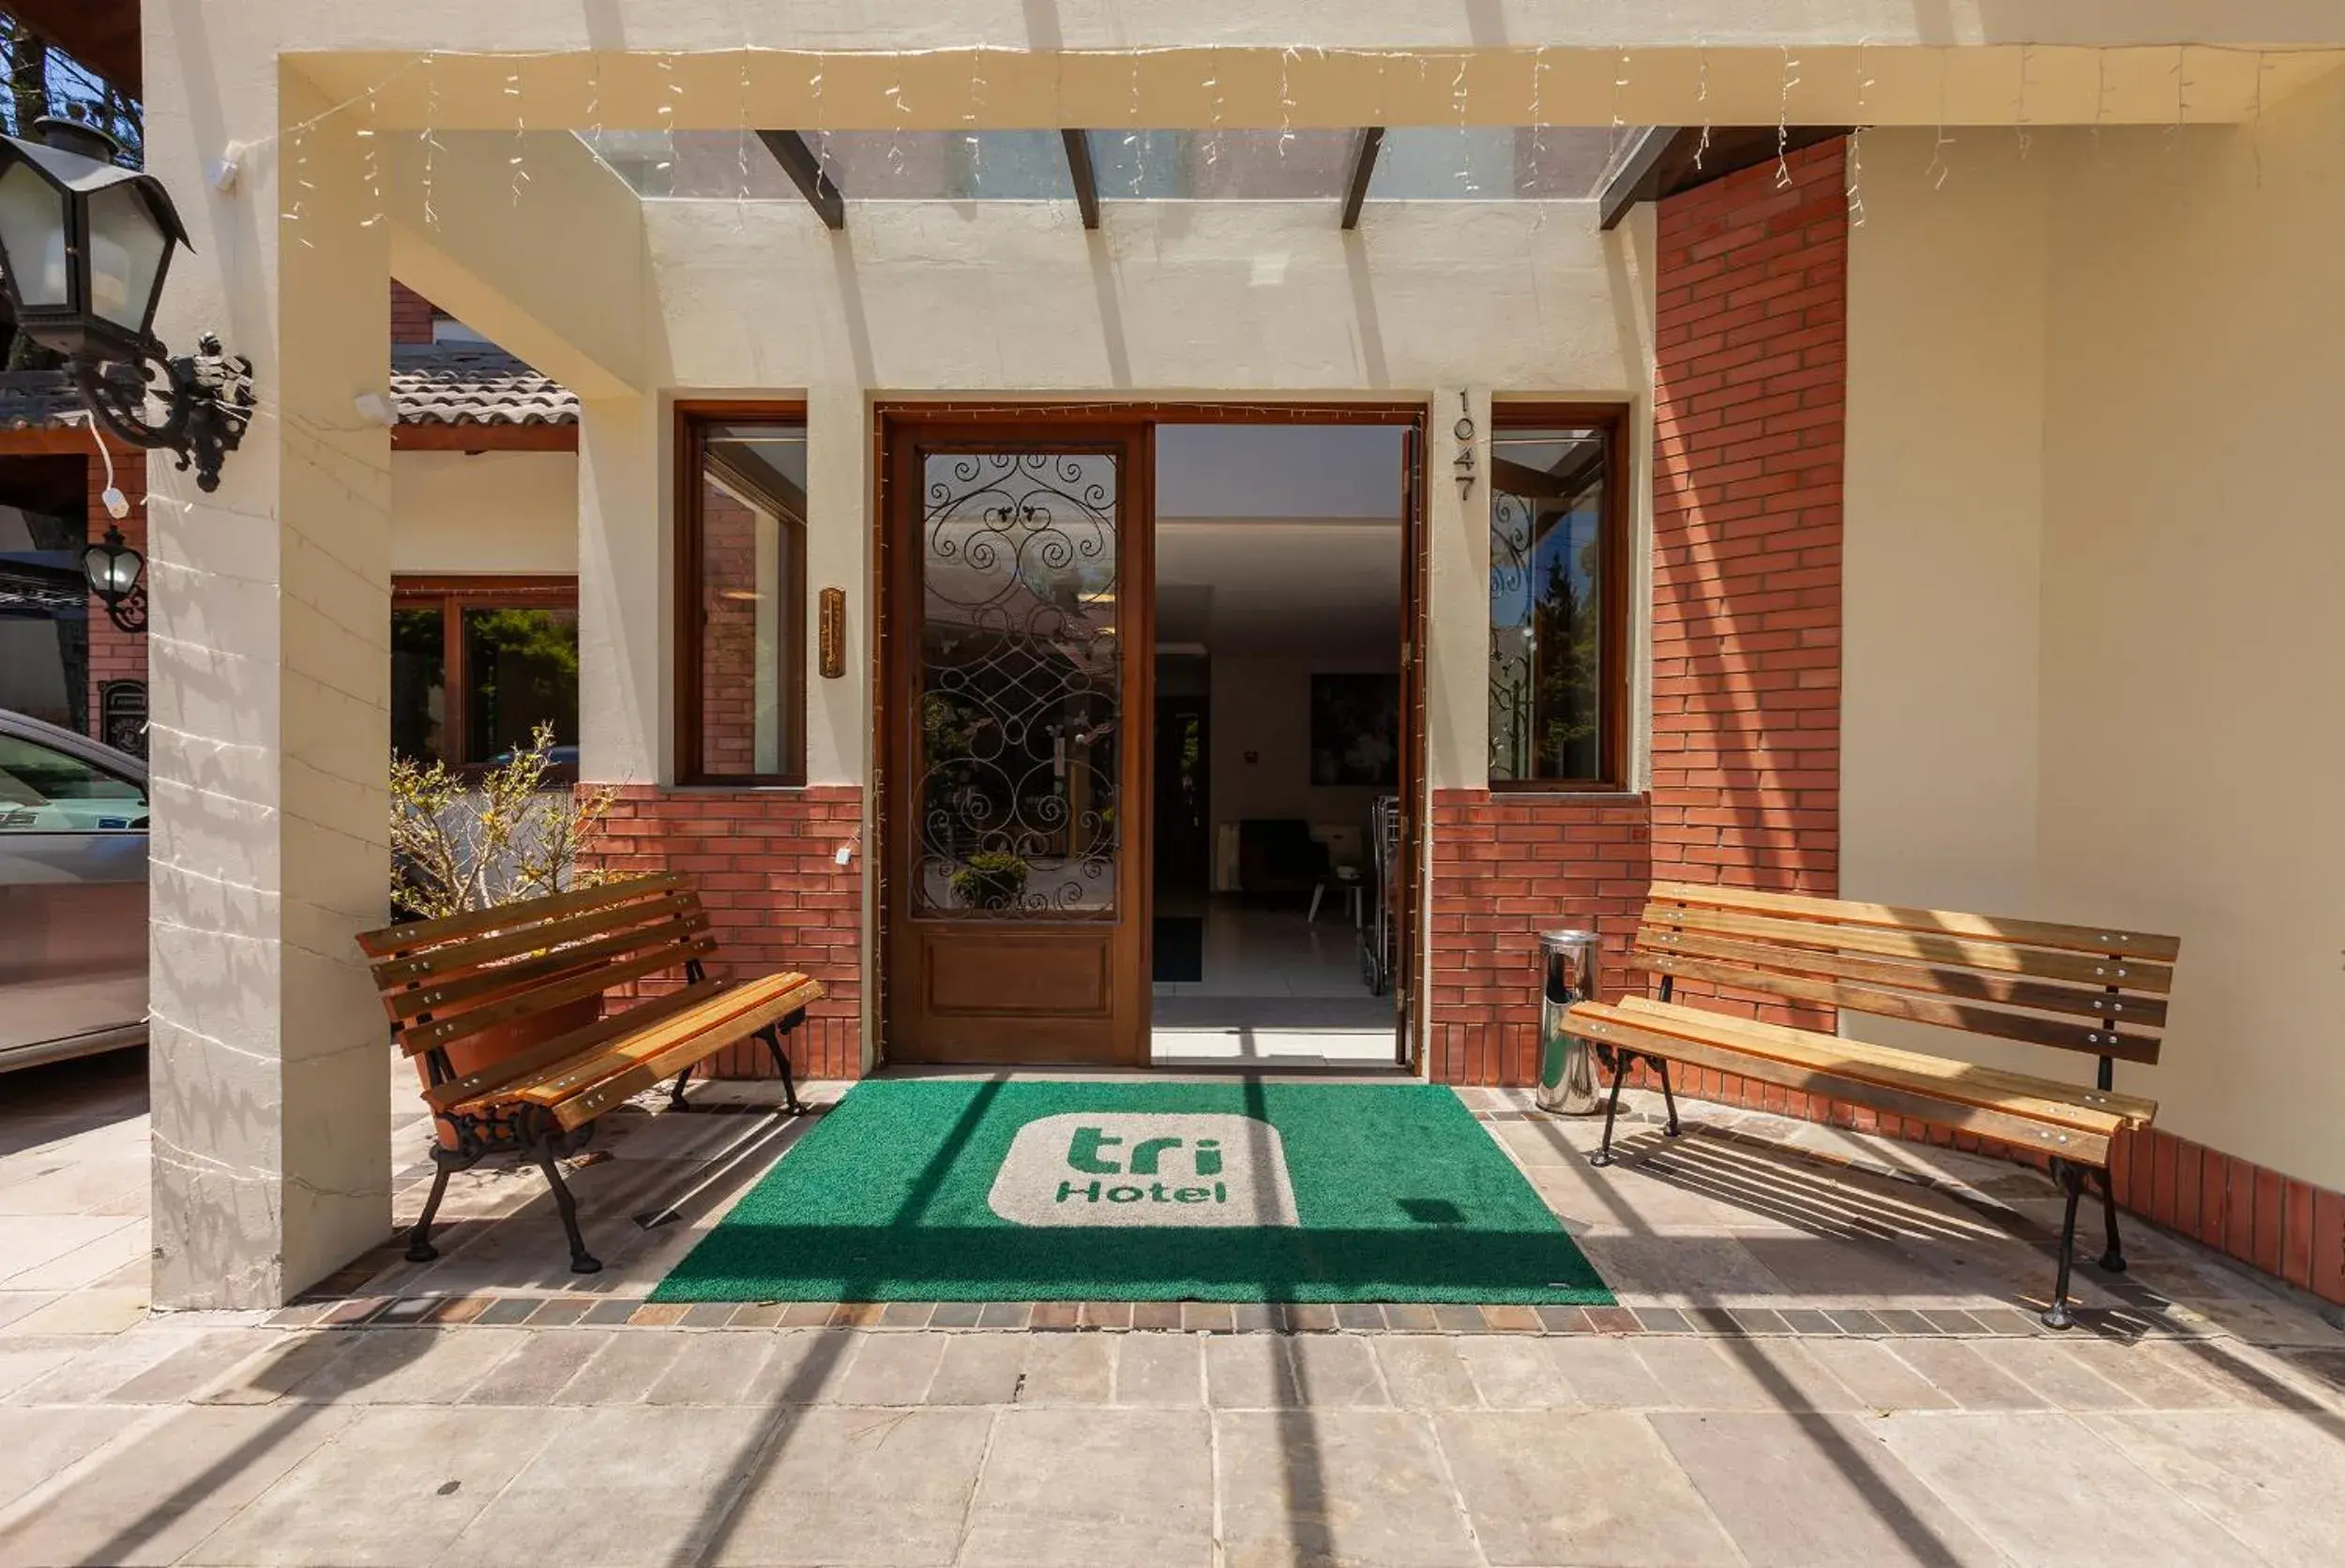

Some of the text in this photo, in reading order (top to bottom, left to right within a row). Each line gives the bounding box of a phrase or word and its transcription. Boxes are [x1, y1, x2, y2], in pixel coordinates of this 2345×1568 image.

[1453, 387, 1475, 501] 1047
[1067, 1127, 1222, 1175] tri
[1056, 1181, 1227, 1203] Hotel
